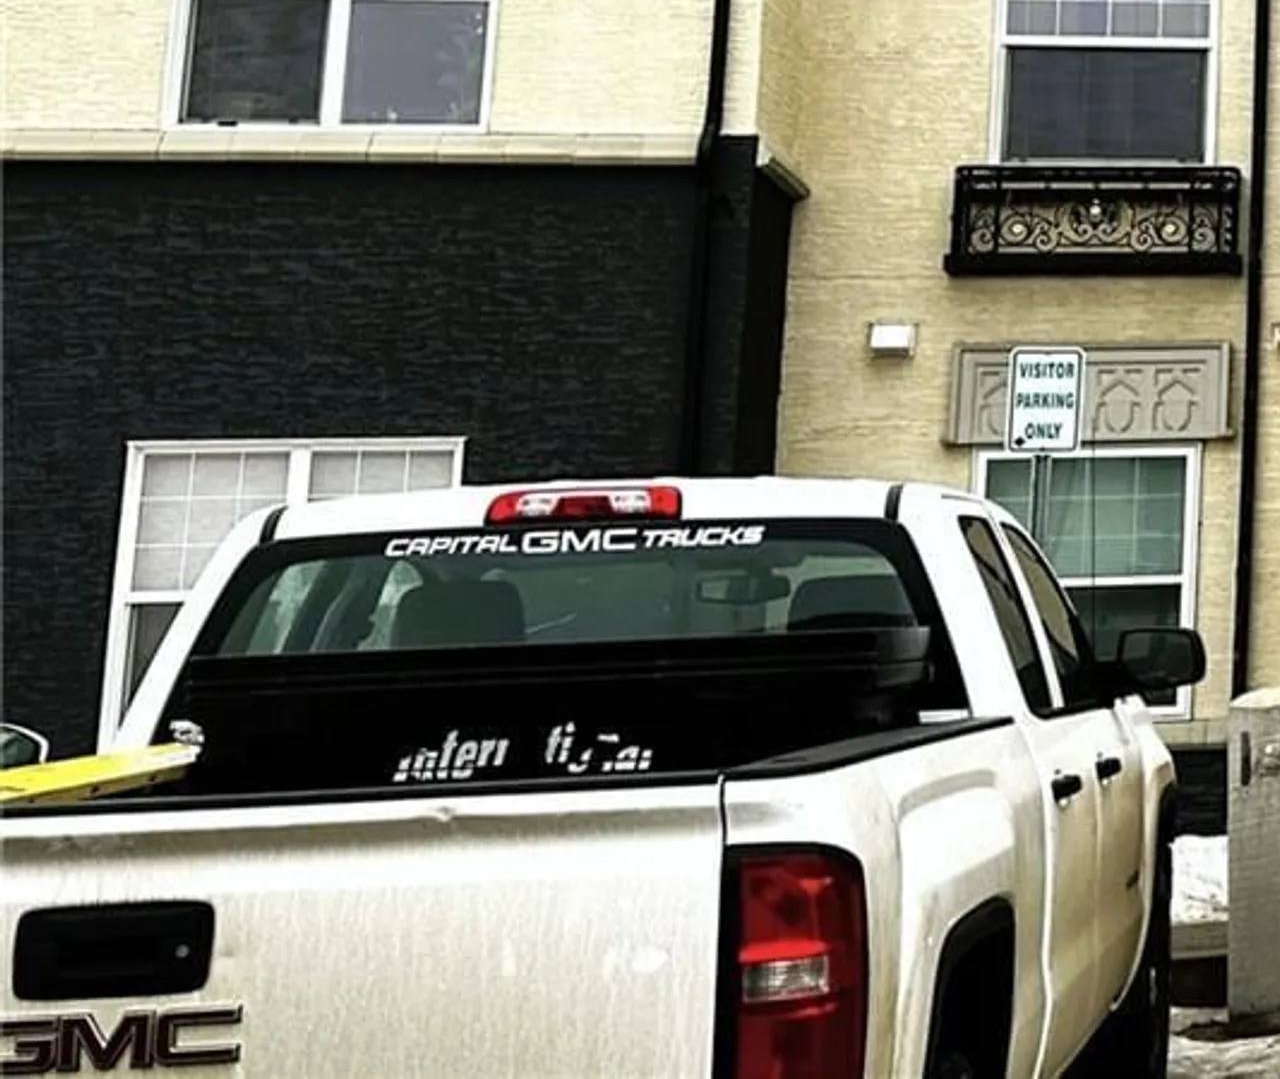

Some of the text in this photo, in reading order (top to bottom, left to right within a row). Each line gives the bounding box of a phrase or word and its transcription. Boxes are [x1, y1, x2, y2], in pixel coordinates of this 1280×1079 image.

[1020, 362, 1075, 378] VISITOR
[1016, 392, 1074, 409] PARKING
[1025, 422, 1063, 439] ONLY
[385, 525, 765, 557] CAPITAL GMC TRUCKS
[0, 1004, 244, 1075] GMC
